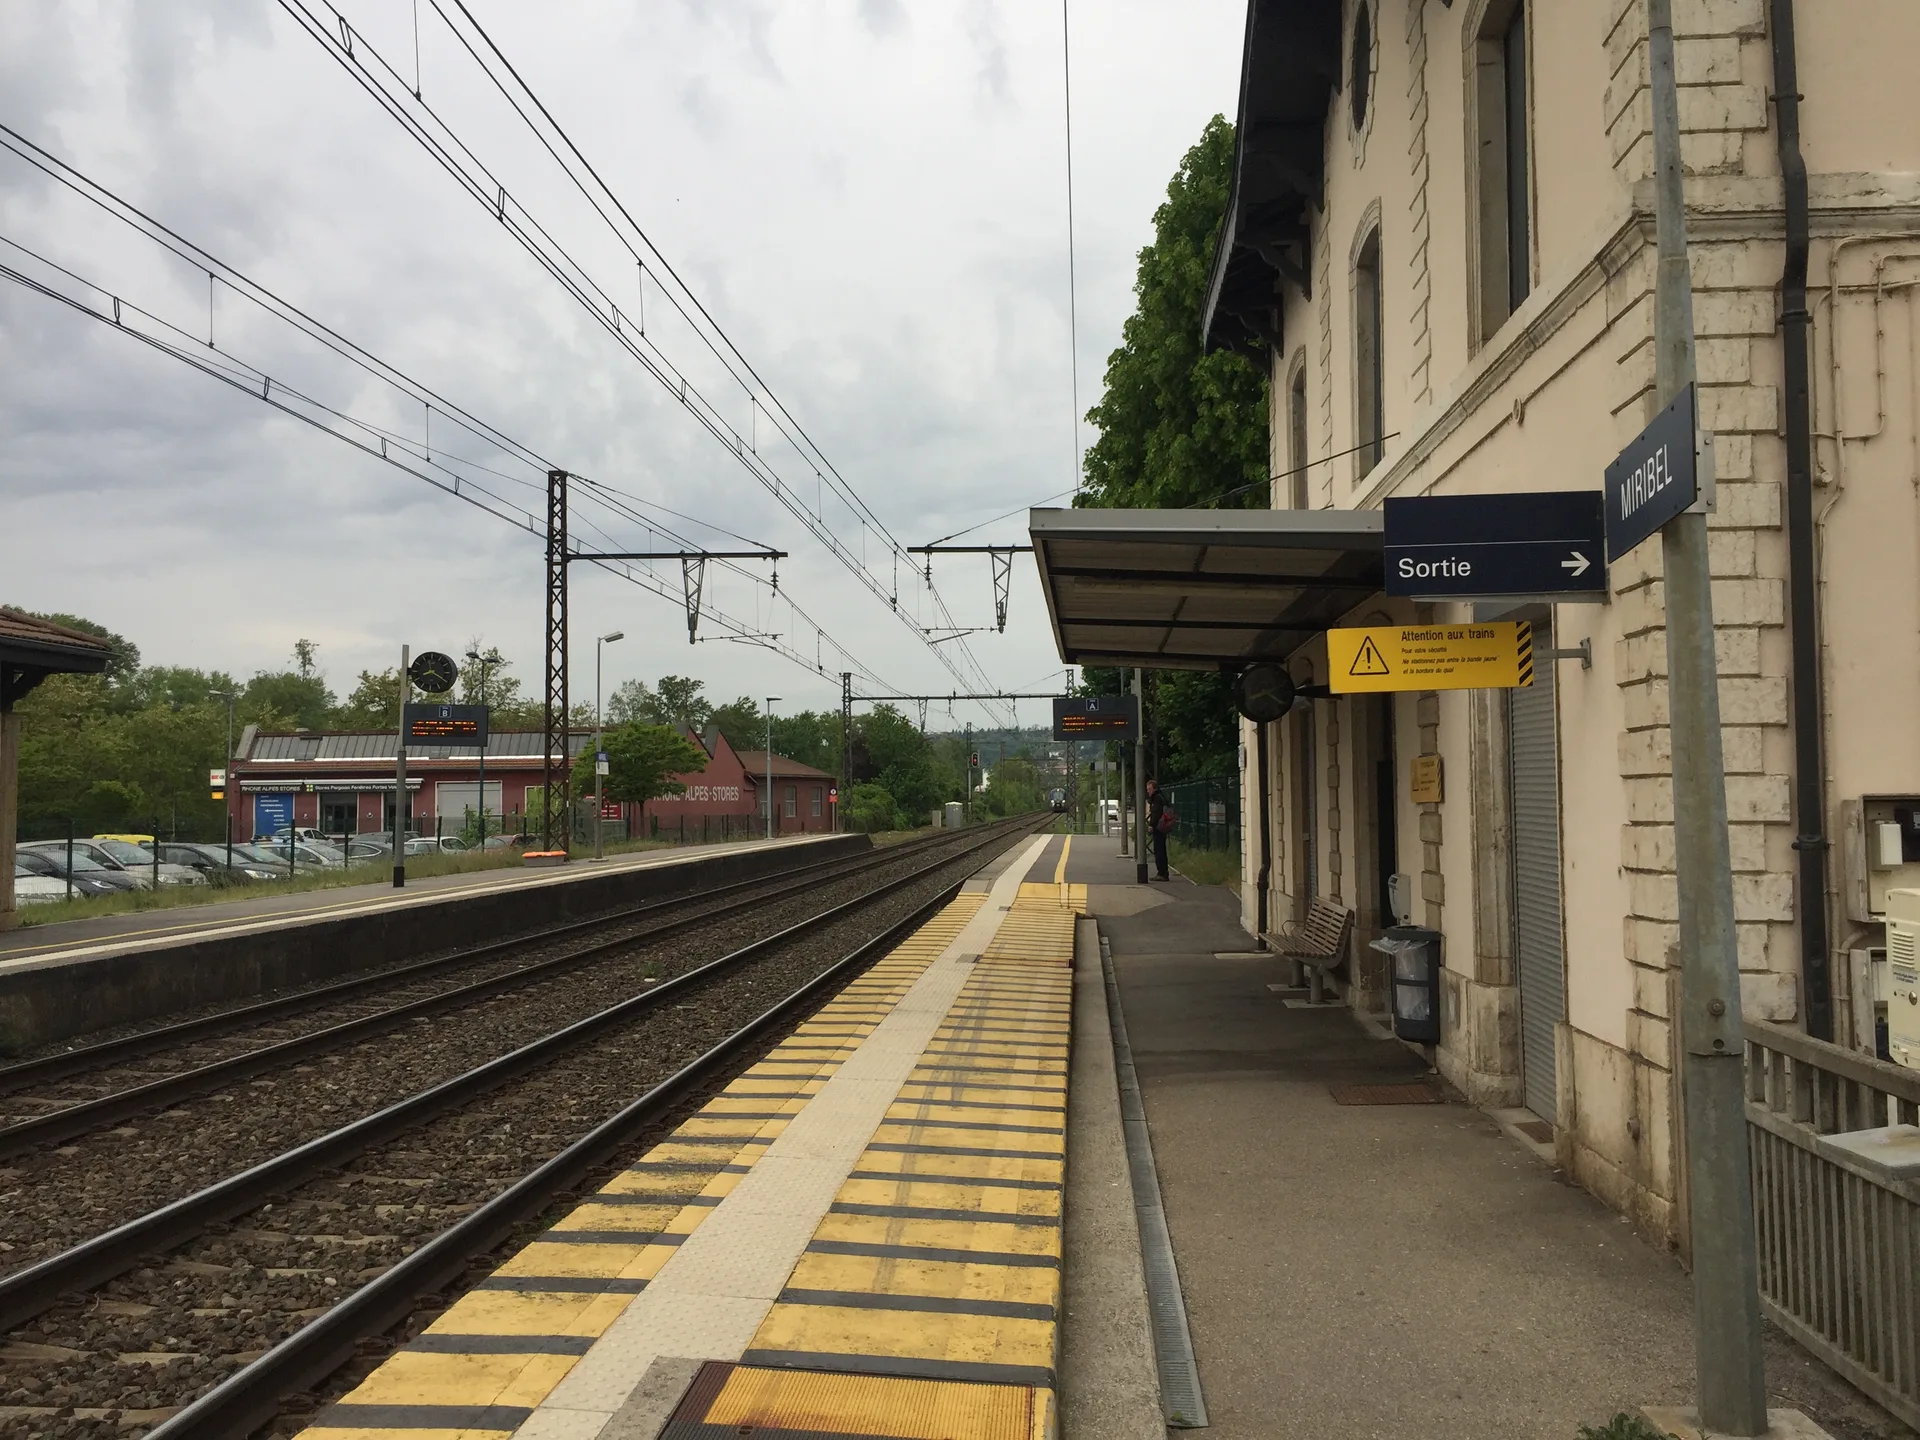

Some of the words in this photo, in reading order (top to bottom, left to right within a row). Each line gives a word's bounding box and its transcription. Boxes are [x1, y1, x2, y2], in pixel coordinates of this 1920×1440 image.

[1621, 444, 1673, 521] MIRIBEL
[1398, 556, 1471, 578] Sortie
[1401, 630, 1444, 641] Attention
[1447, 630, 1464, 640] aux
[1468, 628, 1495, 639] trains
[1443, 666, 1455, 674] quai
